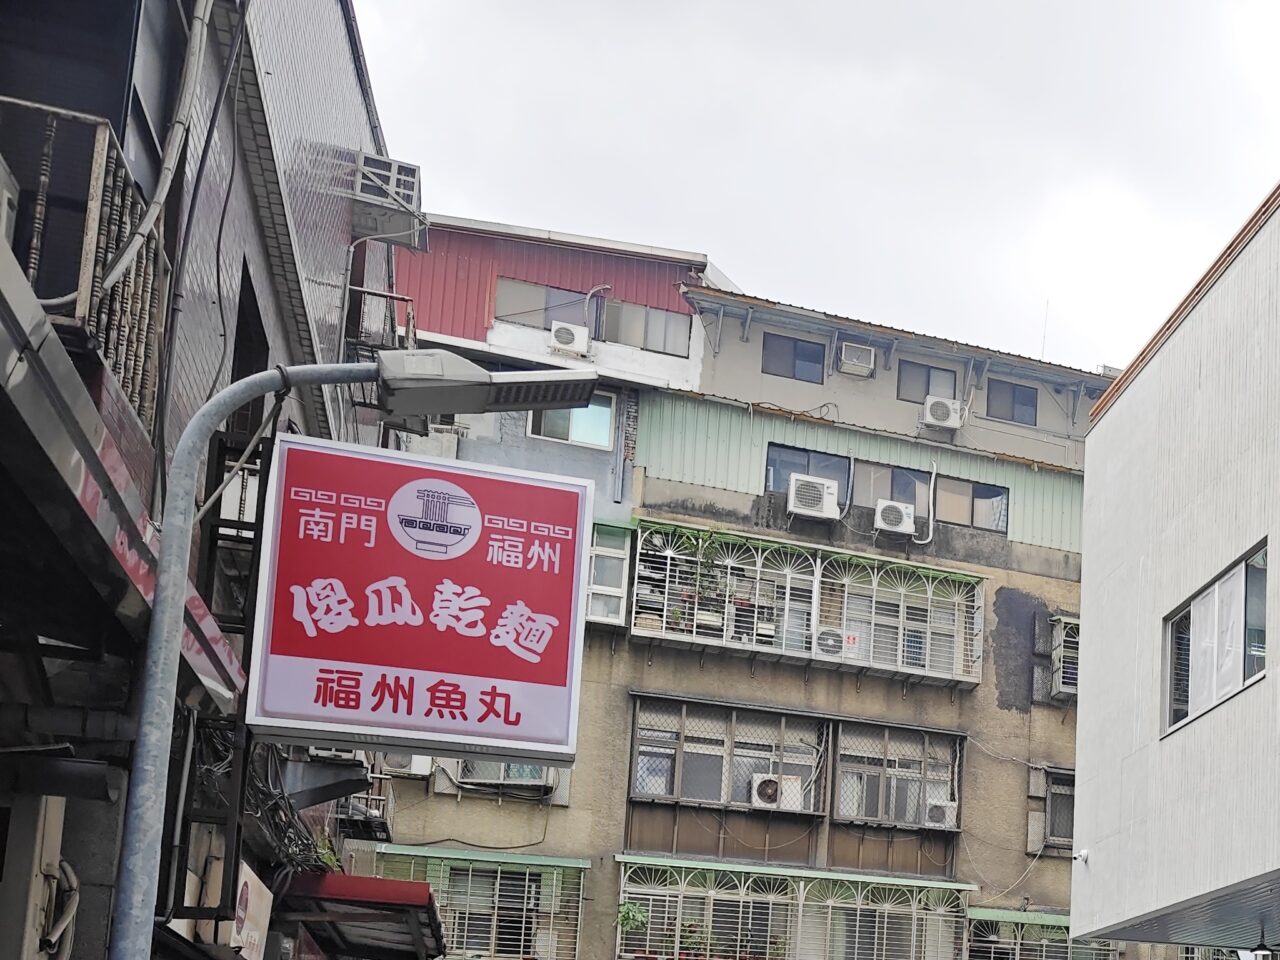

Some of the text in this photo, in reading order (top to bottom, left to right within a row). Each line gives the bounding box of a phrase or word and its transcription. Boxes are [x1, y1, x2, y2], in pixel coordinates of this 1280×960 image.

[298, 507, 377, 548] 南門
[486, 534, 561, 574] 福州
[289, 576, 559, 664] 傻瓜乾麵
[313, 668, 522, 726] 福州魚丸
